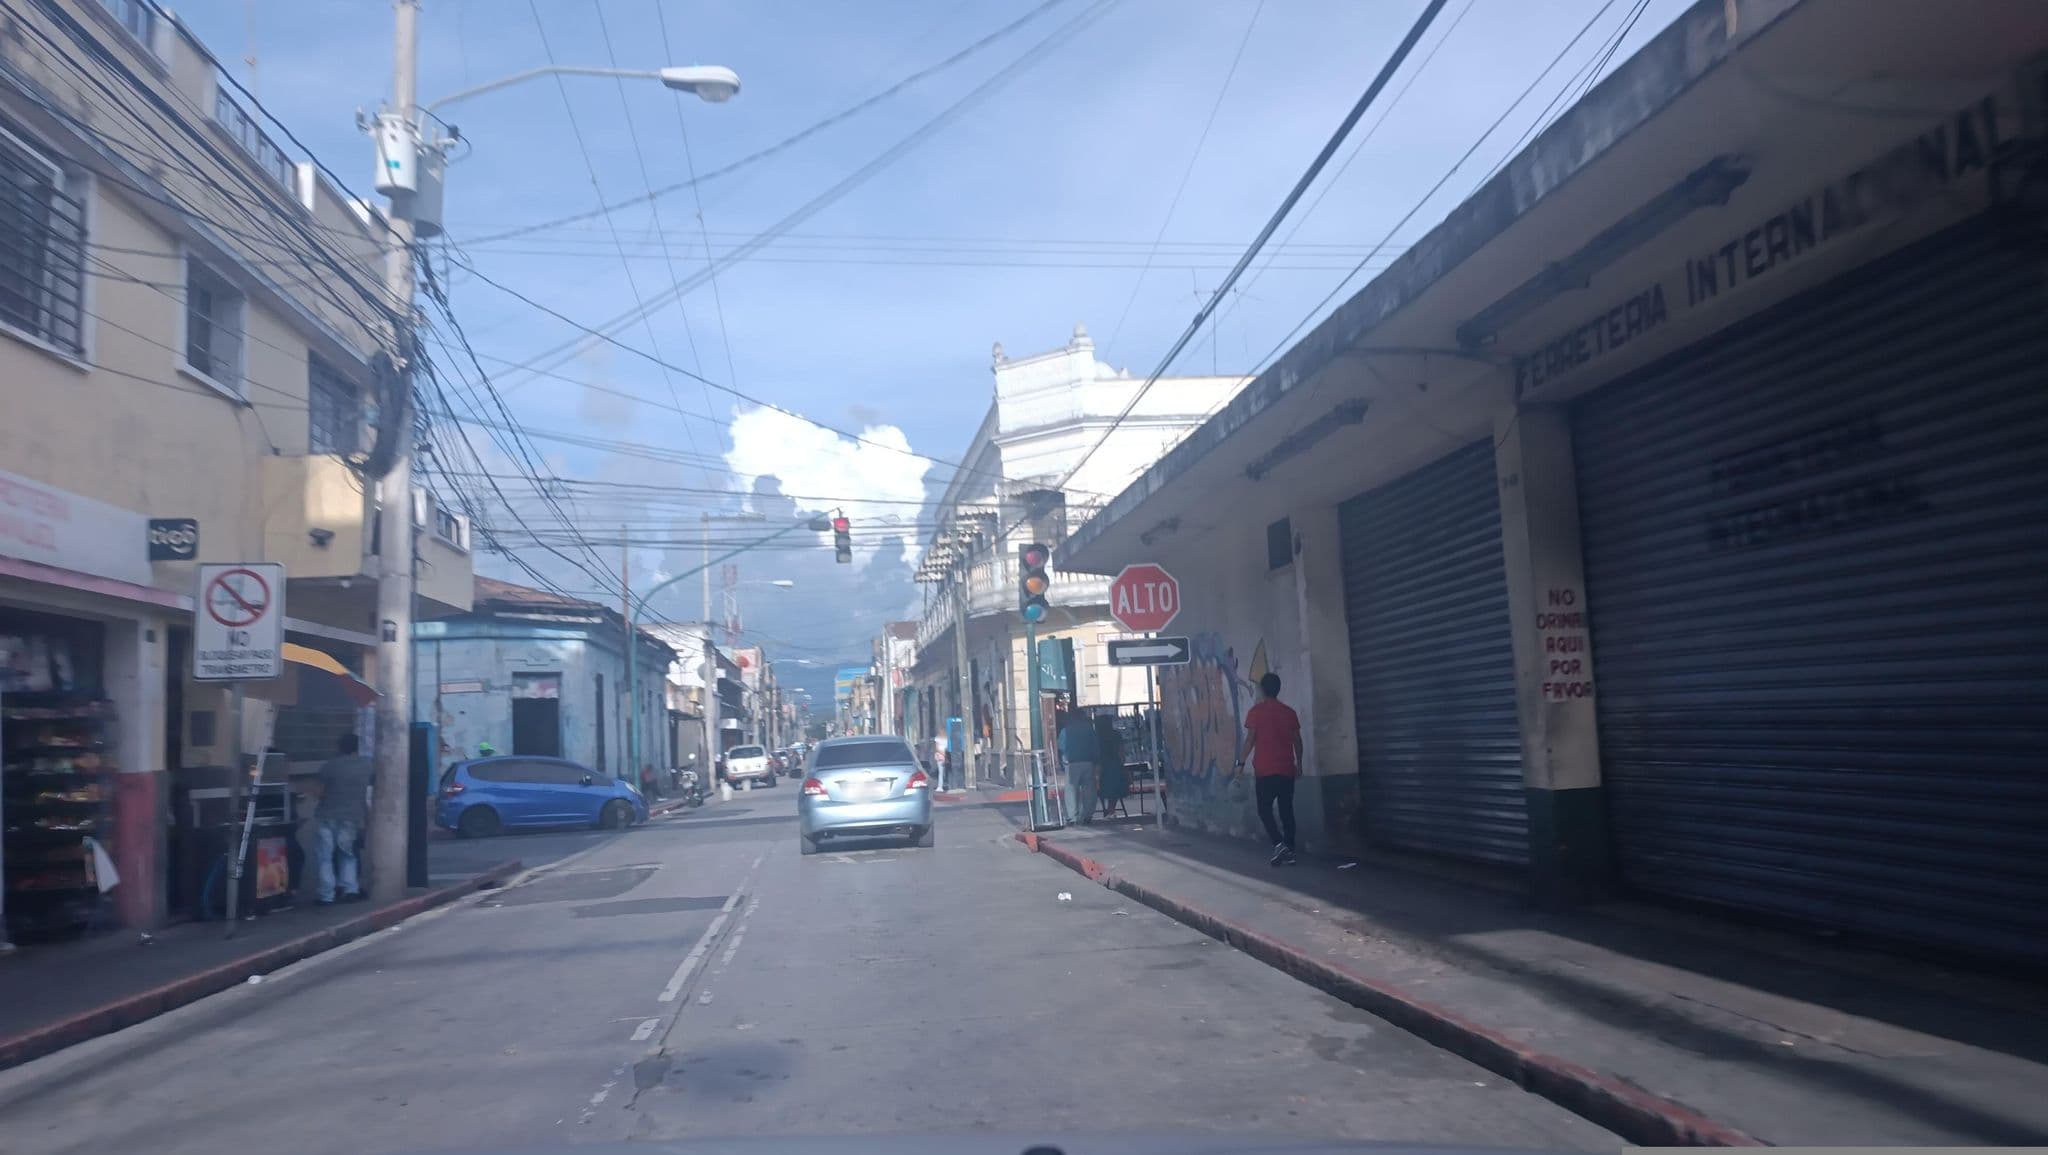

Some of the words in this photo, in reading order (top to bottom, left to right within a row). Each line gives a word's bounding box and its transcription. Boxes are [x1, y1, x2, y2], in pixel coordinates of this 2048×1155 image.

[1515, 282, 1667, 394] FERRETERIA
[1686, 94, 2016, 308] INTERNACNAL
[1117, 582, 1173, 615] ALTO
[1548, 589, 1576, 606] NO
[227, 630, 251, 647] NO
[1546, 637, 1584, 653] AQUI
[1550, 659, 1582, 675] POR
[1542, 682, 1592, 698] FAVOR
